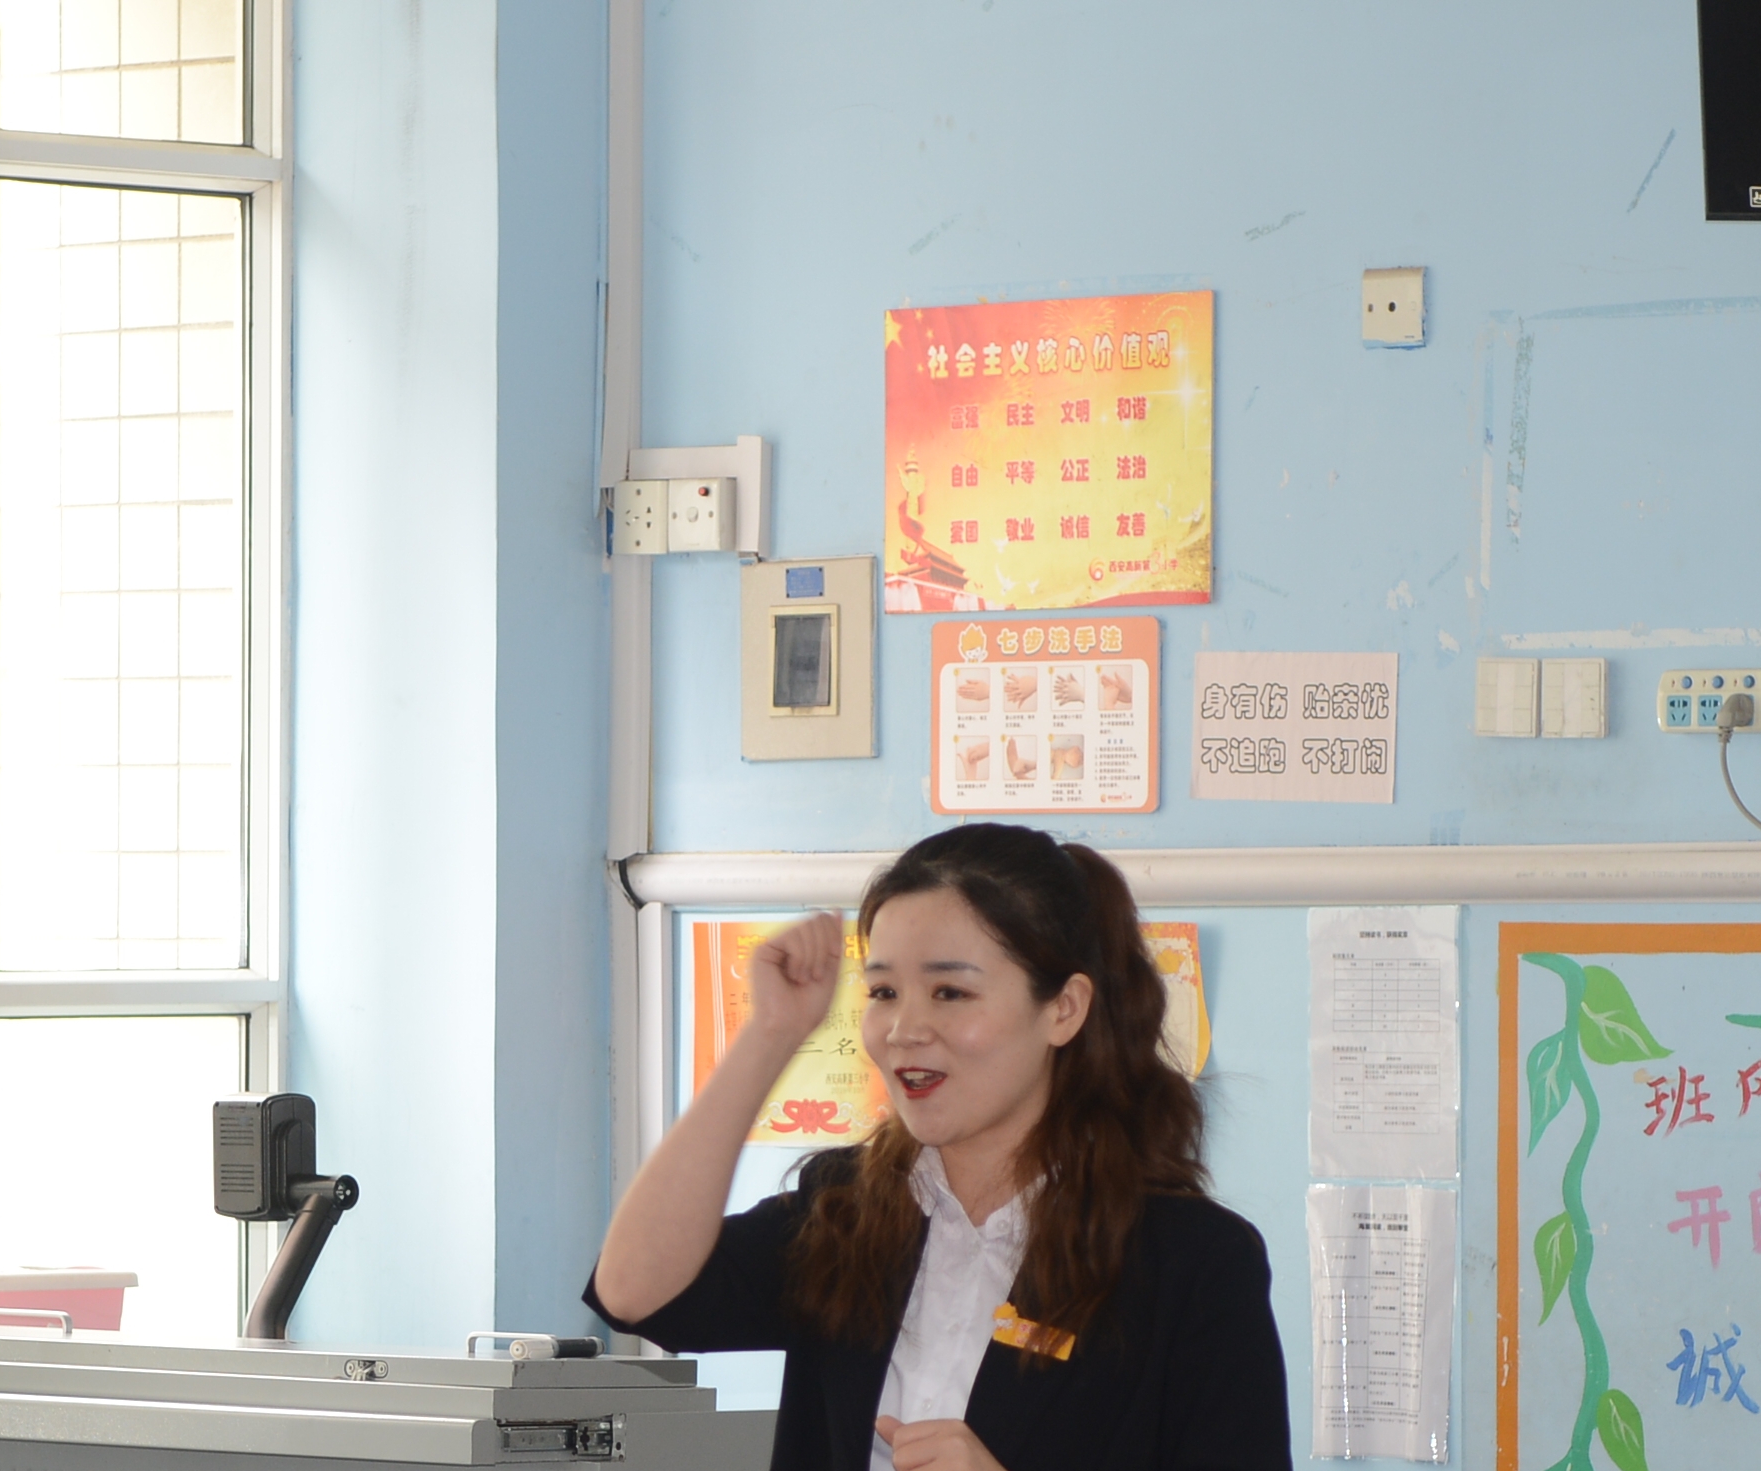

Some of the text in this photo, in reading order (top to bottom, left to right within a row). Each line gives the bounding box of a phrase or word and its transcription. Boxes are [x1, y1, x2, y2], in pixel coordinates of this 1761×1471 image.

[927, 330, 1170, 379] 社会主义核心价值观
[951, 396, 1147, 429] 富强 民主 文明 和谐
[951, 455, 1147, 488] 自由 平等 公正 法治
[950, 512, 1146, 544] 爱国 敬业 诚信 友善
[996, 625, 1123, 656] 七步洗手法
[1201, 682, 1390, 720] 身有伤 贻亲忧
[1201, 737, 1388, 775] 不追跑 不打闹
